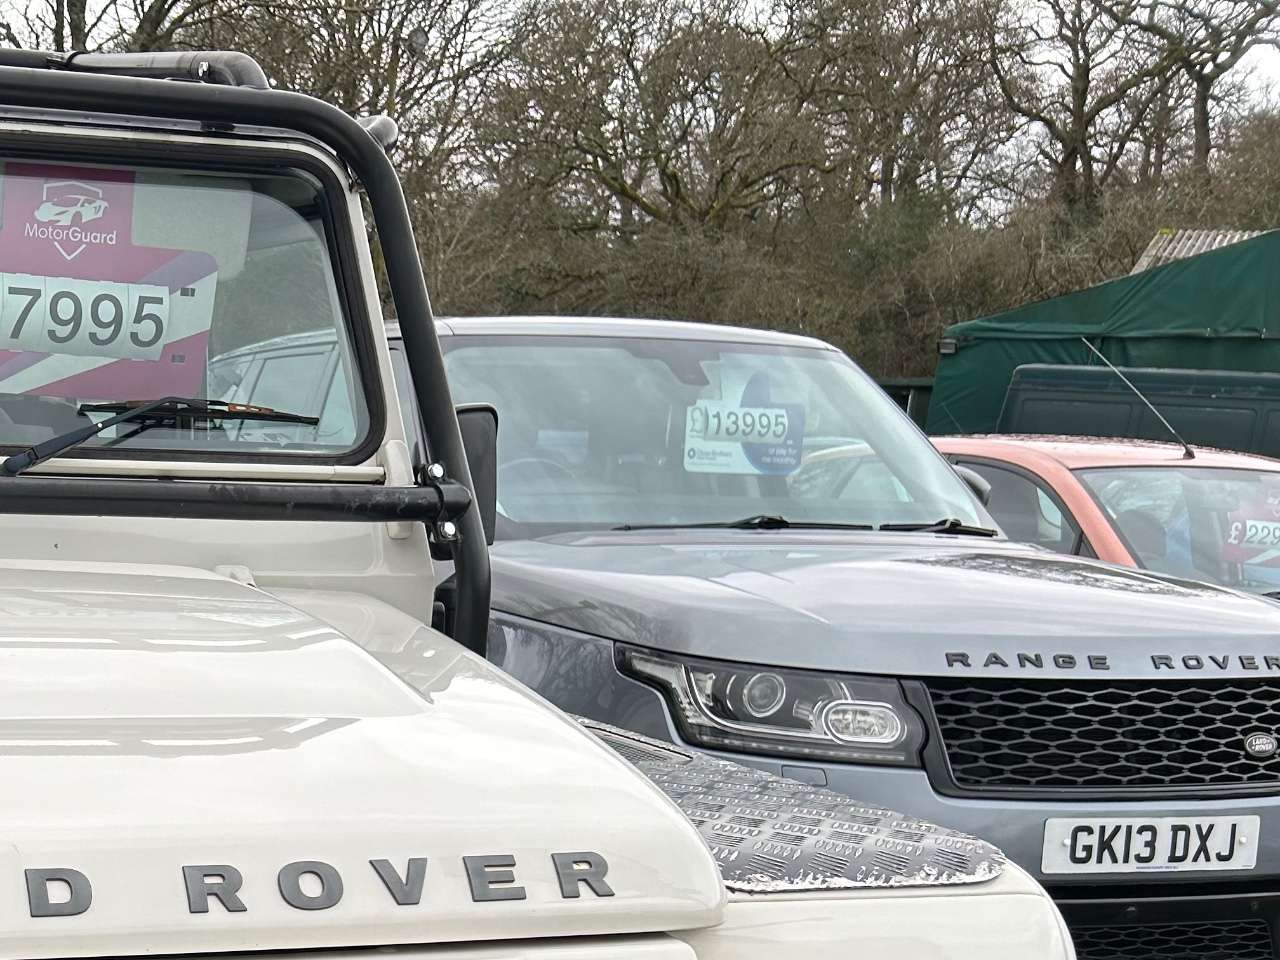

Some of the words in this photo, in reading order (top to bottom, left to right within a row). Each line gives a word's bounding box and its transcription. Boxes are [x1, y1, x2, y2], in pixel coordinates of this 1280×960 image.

[24, 222, 117, 246] MotorGuard
[945, 651, 1111, 670] RANGE
[1151, 654, 1280, 670] ROVER
[1069, 823, 1158, 865] GK13
[1167, 822, 1238, 864] DXJ
[182, 850, 616, 914] ROVER
